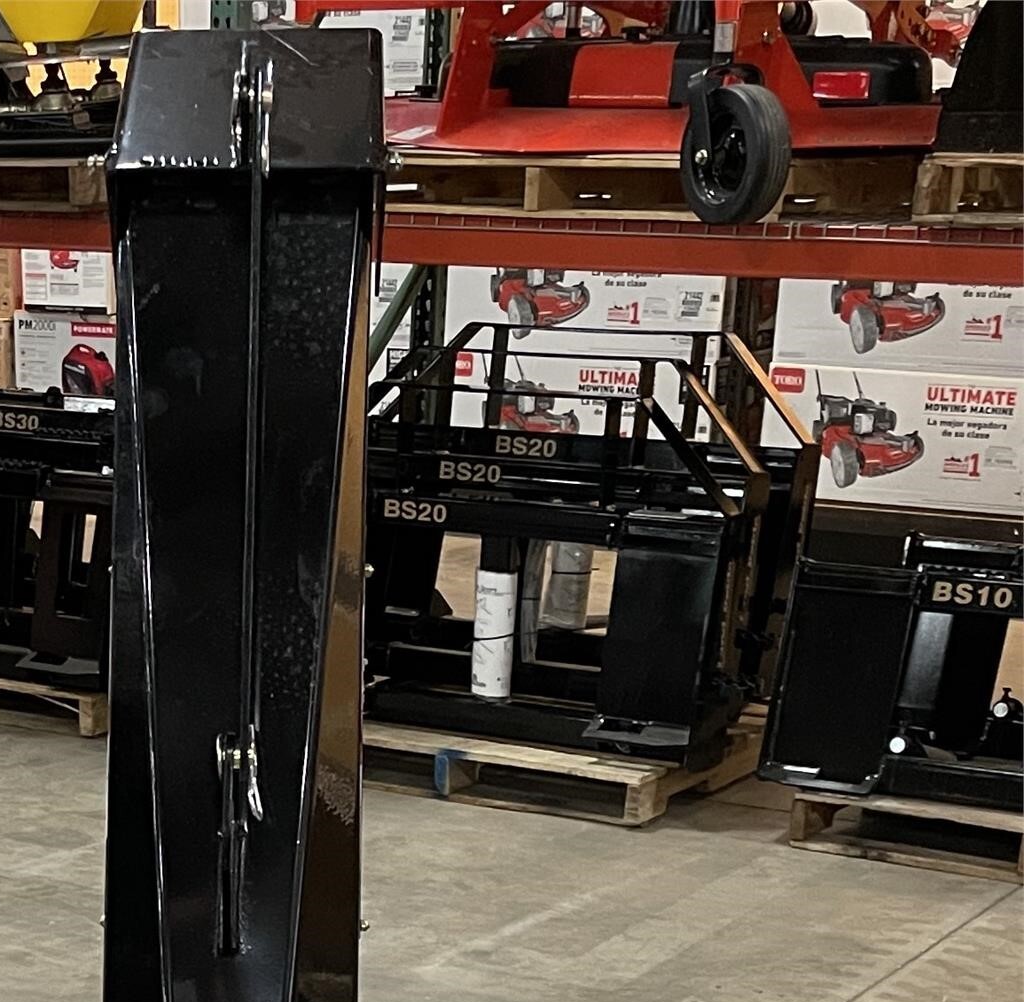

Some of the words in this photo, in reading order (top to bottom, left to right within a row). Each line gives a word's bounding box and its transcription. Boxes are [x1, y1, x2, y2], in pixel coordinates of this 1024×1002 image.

[988, 291, 1012, 299] clase
[73, 325, 114, 334] POWERMATE
[579, 369, 640, 386] ULTIMA
[773, 374, 803, 386] TORO
[578, 384, 615, 394] MOWING
[927, 386, 1017, 406] ULTIMATE
[924, 403, 968, 413] MOWING
[969, 405, 1015, 417] MACHINE
[927, 418, 938, 426] La
[940, 420, 965, 429] mejor
[495, 435, 558, 458] BS20
[439, 460, 502, 484] BS20
[384, 499, 448, 523] BS20
[932, 581, 1014, 609] BS10
